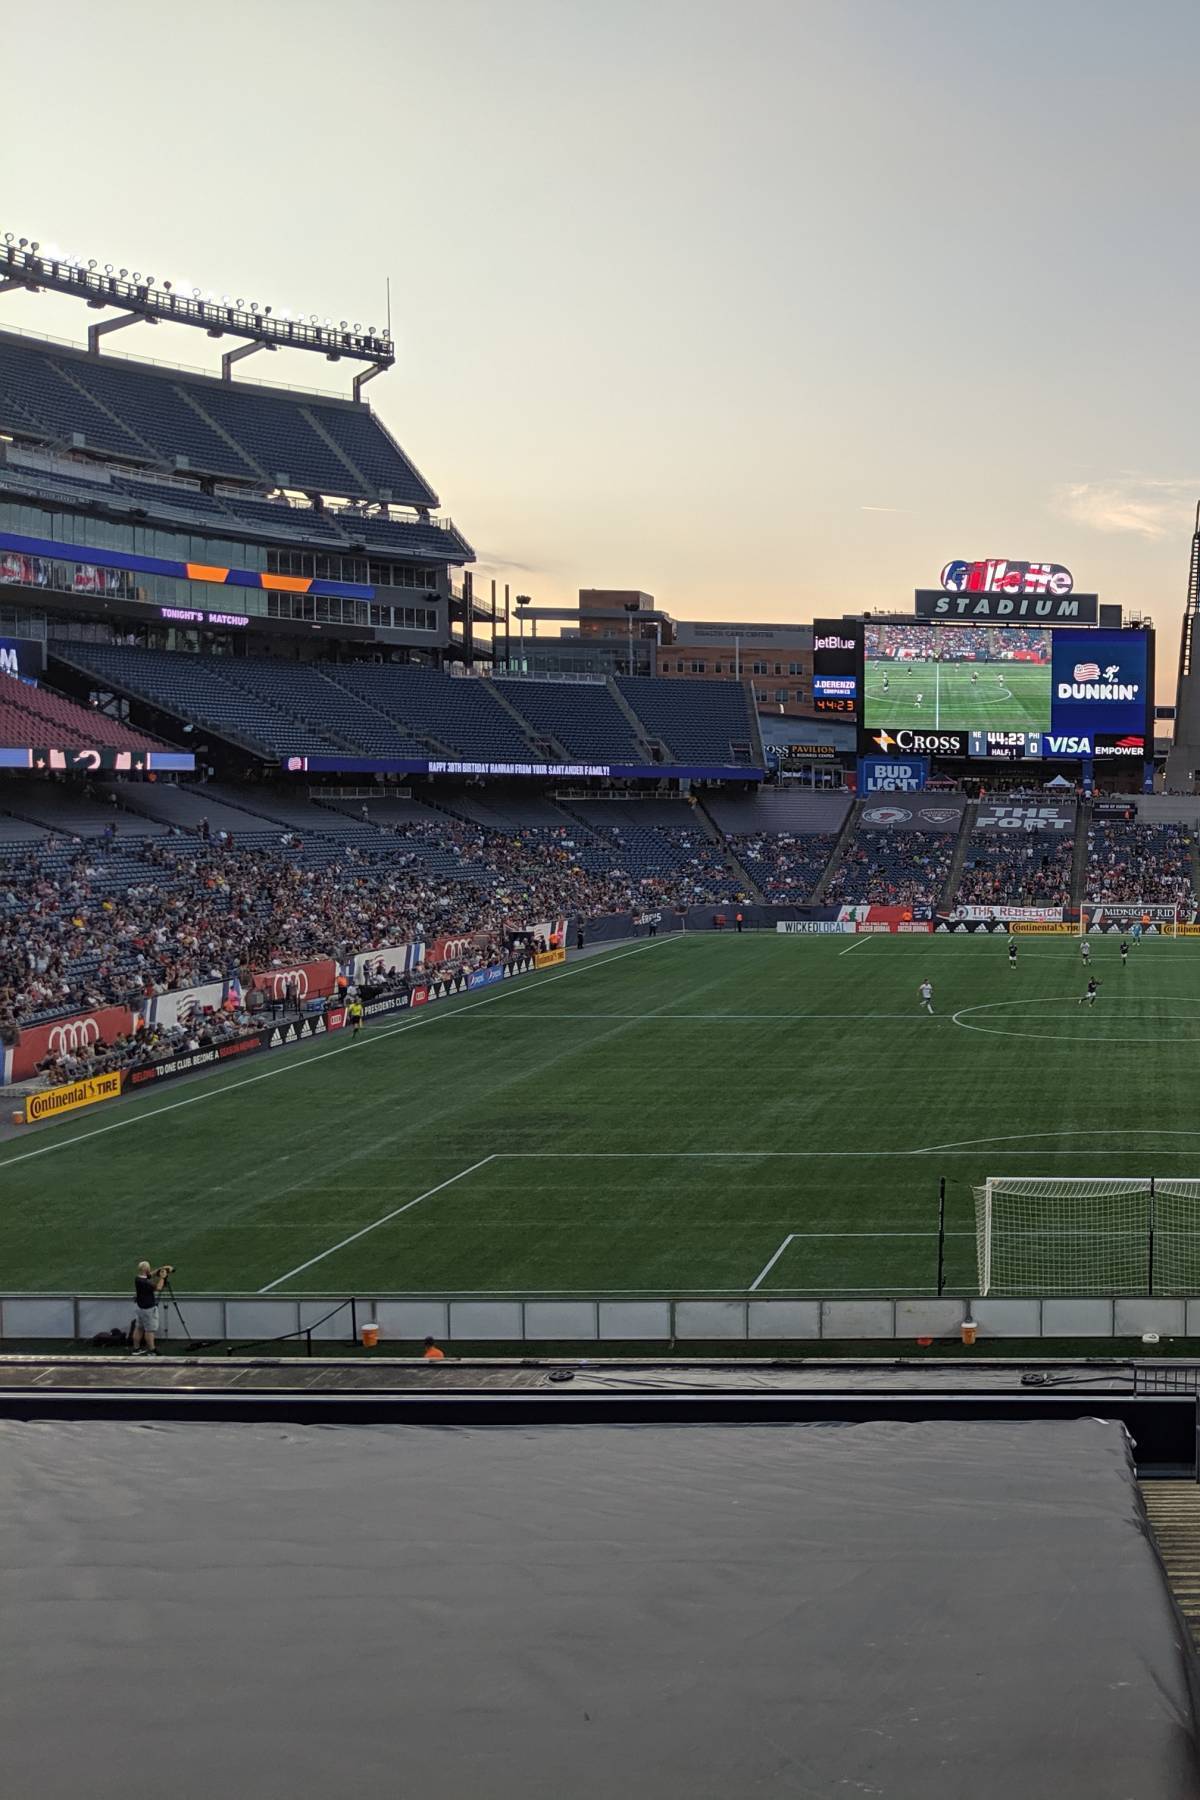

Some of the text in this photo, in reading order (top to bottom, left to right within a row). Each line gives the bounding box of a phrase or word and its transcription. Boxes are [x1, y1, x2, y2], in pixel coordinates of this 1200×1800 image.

[942, 559, 1073, 594] Gillette
[935, 597, 1080, 616] STADIUM
[161, 608, 249, 625] TONIGHT'S MATCHUP
[814, 636, 856, 651] jetBlue
[814, 680, 856, 689] J.DERENZO
[1058, 684, 1139, 700] DUNKIN'
[817, 701, 854, 711] 44:23
[896, 730, 961, 750] CROSS
[987, 732, 1025, 745] 44:23
[975, 741, 980, 752] 1
[1030, 742, 1038, 753] 0
[1044, 736, 1091, 753] VISA
[991, 748, 1012, 756] HALF:
[1095, 747, 1144, 756] EMPOWER
[429, 762, 446, 772] HAPPY
[874, 765, 912, 777] BUD
[868, 778, 919, 791] LIGHT
[990, 807, 1059, 818] THE
[976, 818, 1072, 829] FORT
[1000, 908, 1062, 917] REBELLION
[1104, 909, 1191, 917] MIDNIGHT RIDRS
[785, 922, 846, 932] WICKEDLOCAL
[1012, 923, 1057, 933] Continental
[364, 1000, 395, 1016] PRESIDENTS
[395, 995, 409, 1007] CLUB
[156, 1065, 164, 1077] TO
[165, 1063, 176, 1076] ONE
[193, 1053, 213, 1069] BECOME
[213, 1050, 219, 1061] A
[30, 1078, 118, 1118] Continental TIRE
